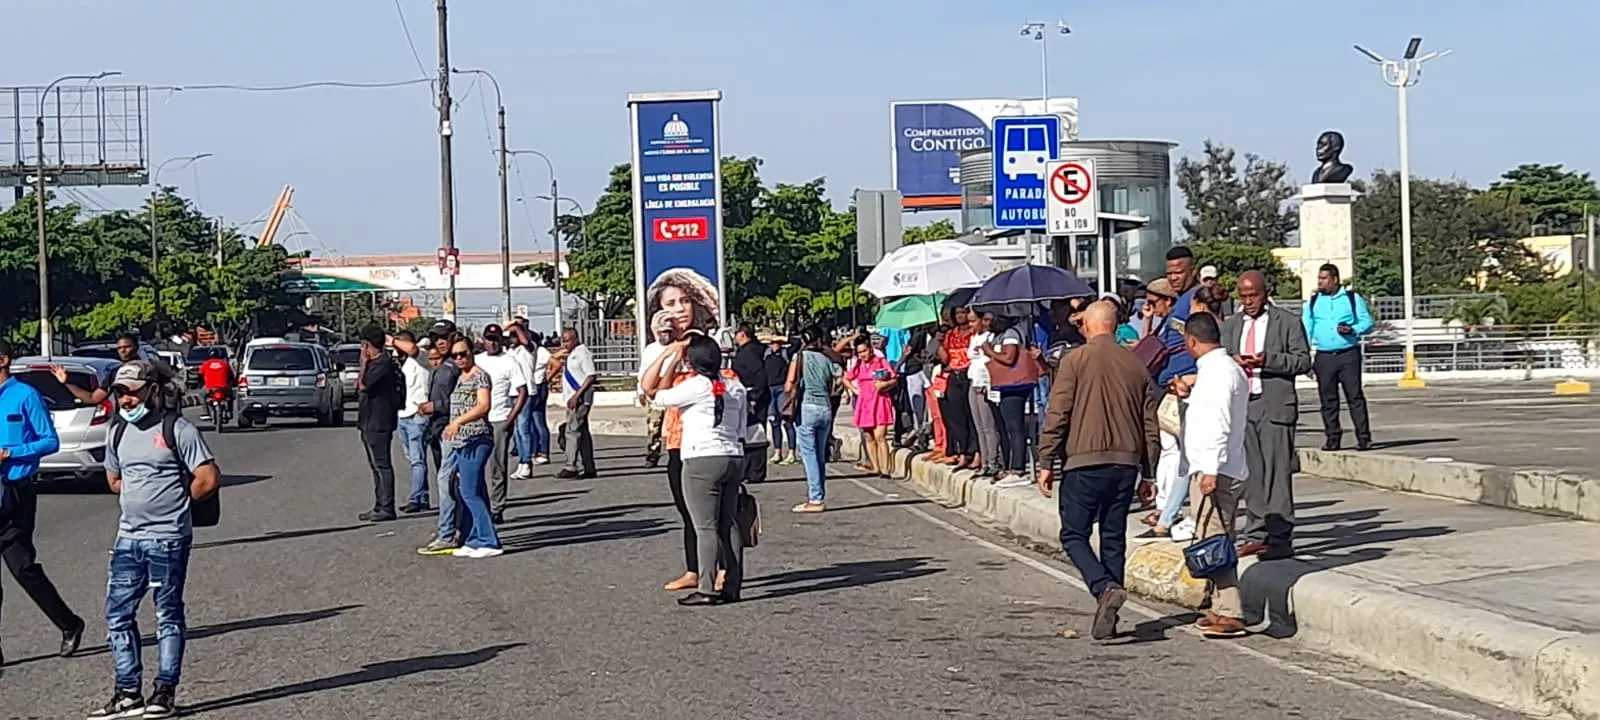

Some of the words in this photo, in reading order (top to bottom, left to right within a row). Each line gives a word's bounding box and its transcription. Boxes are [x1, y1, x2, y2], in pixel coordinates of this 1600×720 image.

[904, 127, 984, 137] COMPROMETIDOS
[911, 137, 985, 151] CONTIGO
[669, 182, 700, 191] POSIBLE
[664, 200, 673, 208] DE
[1001, 208, 1045, 220] AUTOBU
[1064, 207, 1076, 217] NO
